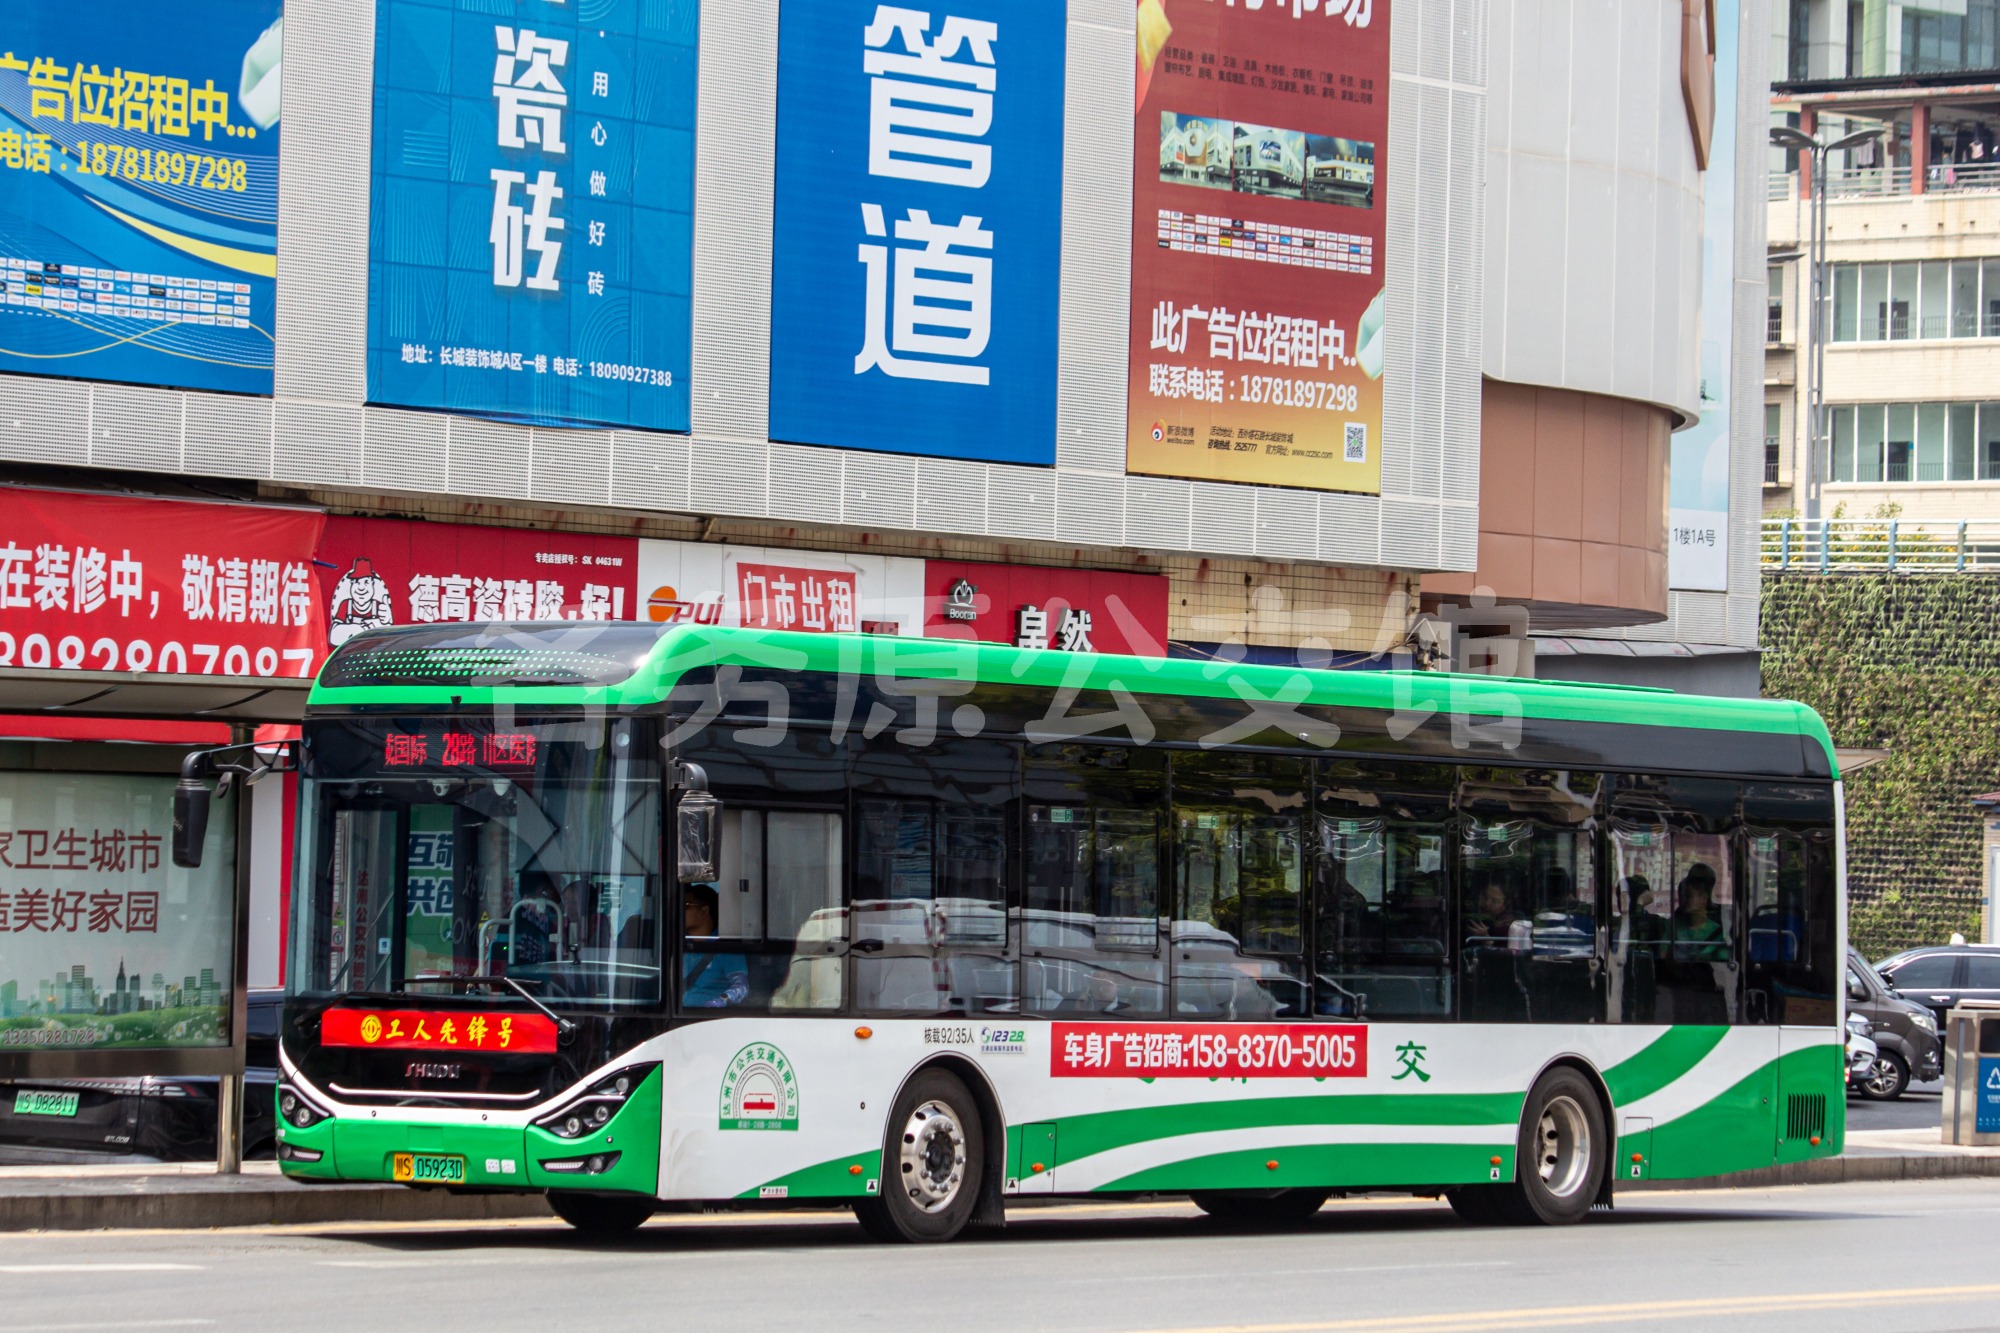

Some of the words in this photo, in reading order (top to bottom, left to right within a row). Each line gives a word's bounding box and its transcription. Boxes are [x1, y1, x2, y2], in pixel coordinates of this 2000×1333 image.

[490, 25, 569, 291] 瓷砖
[587, 71, 609, 297] 用心做好砖
[855, 4, 998, 386] 管道
[553, 357, 672, 387] 电话：18090927388
[1149, 364, 1358, 412] 联系电话：18781897298
[1167, 437, 1195, 446] weibo.com
[743, 571, 855, 632] 门市出租
[950, 608, 977, 620] Booran
[386, 1016, 513, 1048] 工人先锋号
[924, 1027, 974, 1044] 核载92/35人
[991, 1030, 1025, 1042] 12328
[1064, 1032, 1356, 1069] 车身广告招商:158-8370-5005
[1391, 1040, 1431, 1083] 交
